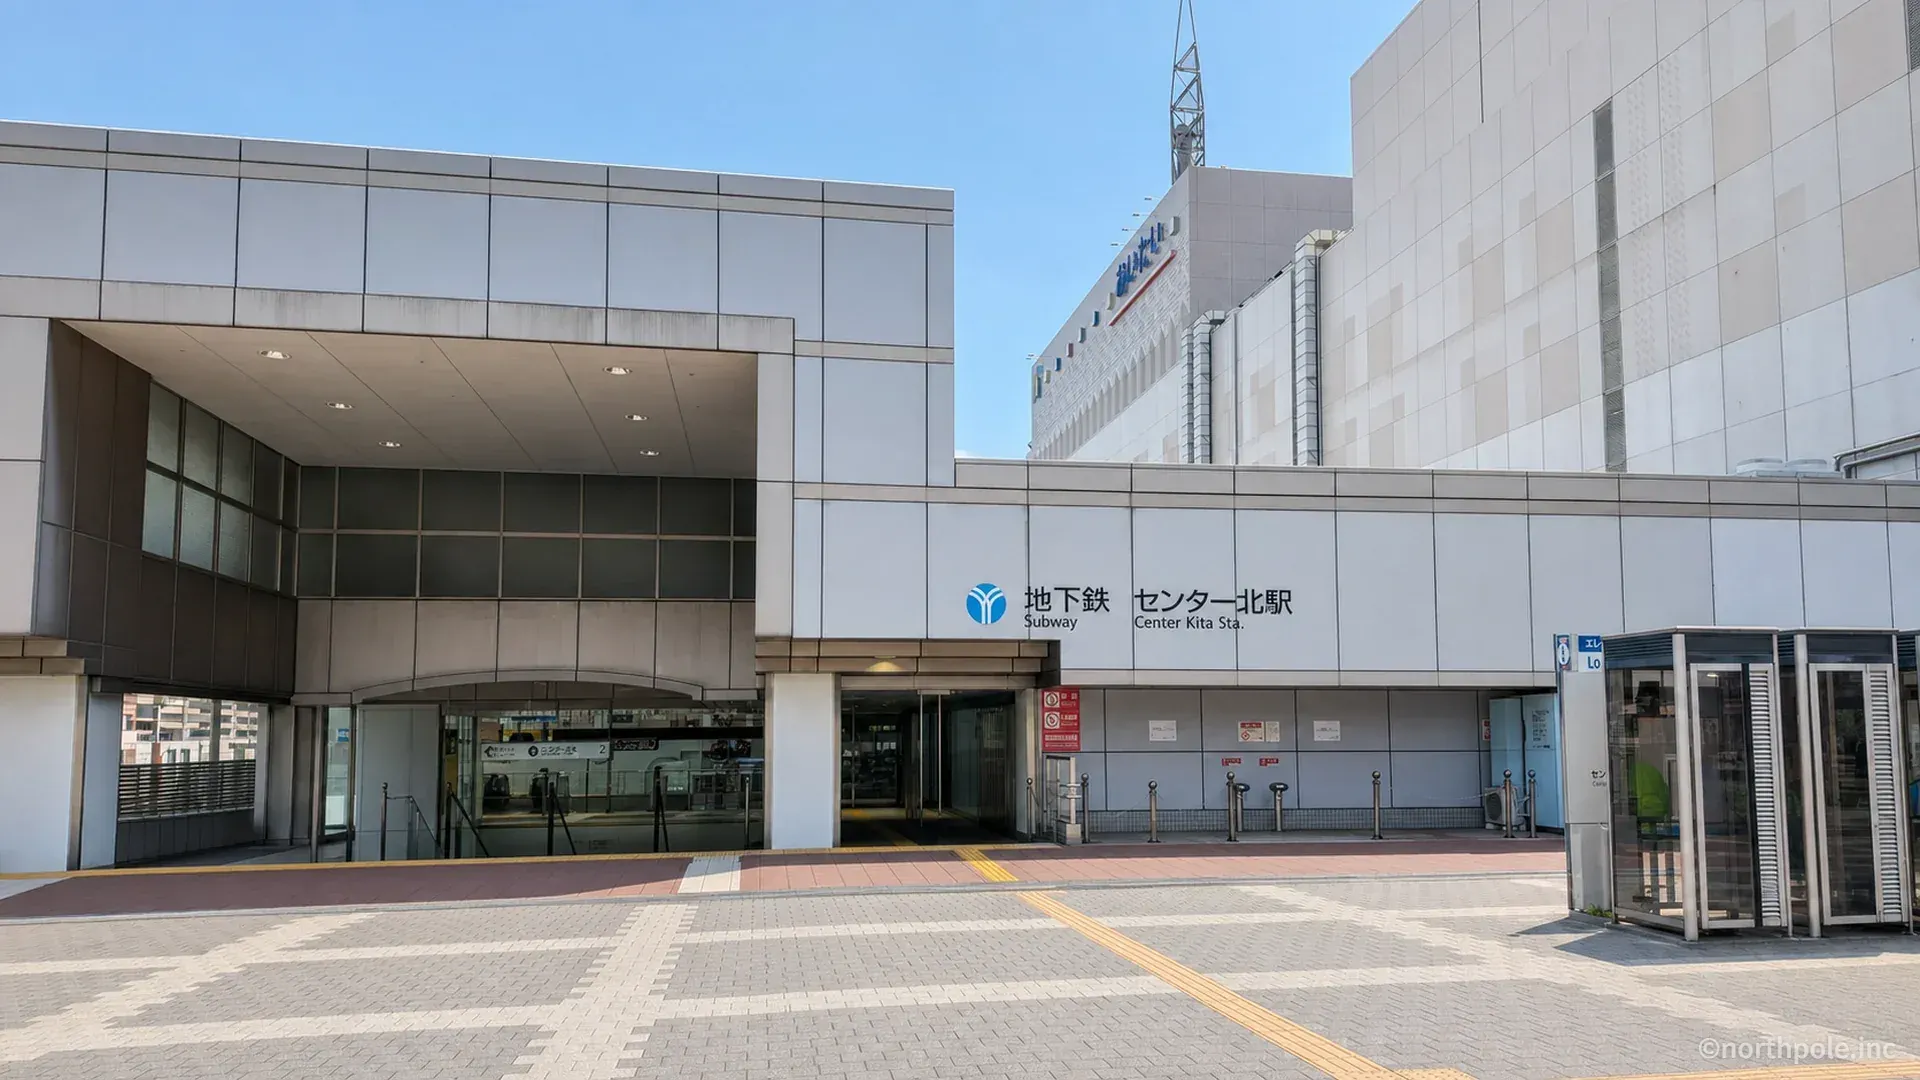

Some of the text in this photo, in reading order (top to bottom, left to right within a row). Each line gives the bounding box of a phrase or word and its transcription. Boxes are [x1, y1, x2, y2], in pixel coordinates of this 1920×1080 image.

[1024, 586, 1293, 615] 地下鉄 センター北駅
[1024, 614, 1078, 631] Subway
[1134, 616, 1244, 630] Center Kita Sta.
[599, 744, 606, 754] 2
